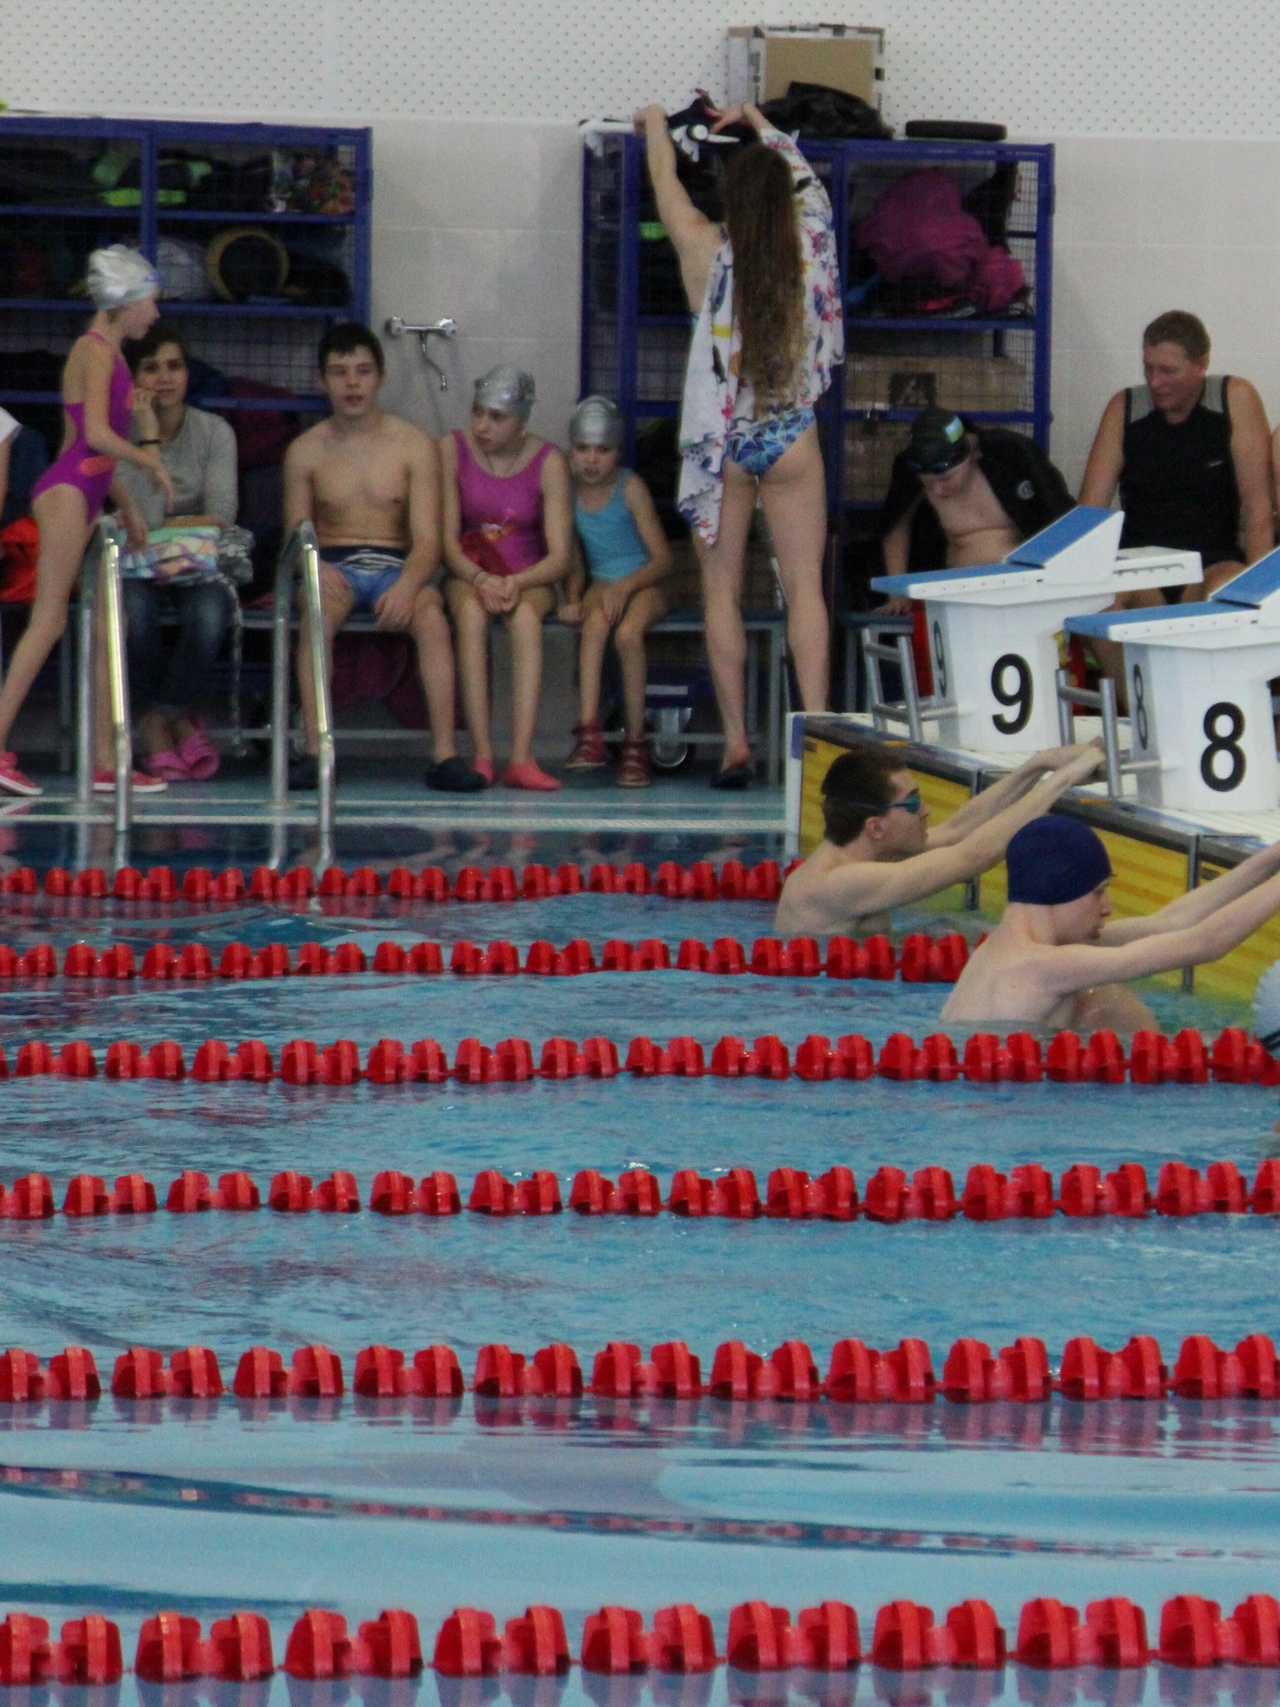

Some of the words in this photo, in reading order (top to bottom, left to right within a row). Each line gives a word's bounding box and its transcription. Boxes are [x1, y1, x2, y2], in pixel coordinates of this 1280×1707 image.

[934, 620, 947, 698] 9
[991, 653, 1033, 735] 9
[1133, 663, 1148, 750] 8
[1200, 701, 1247, 792] 8
